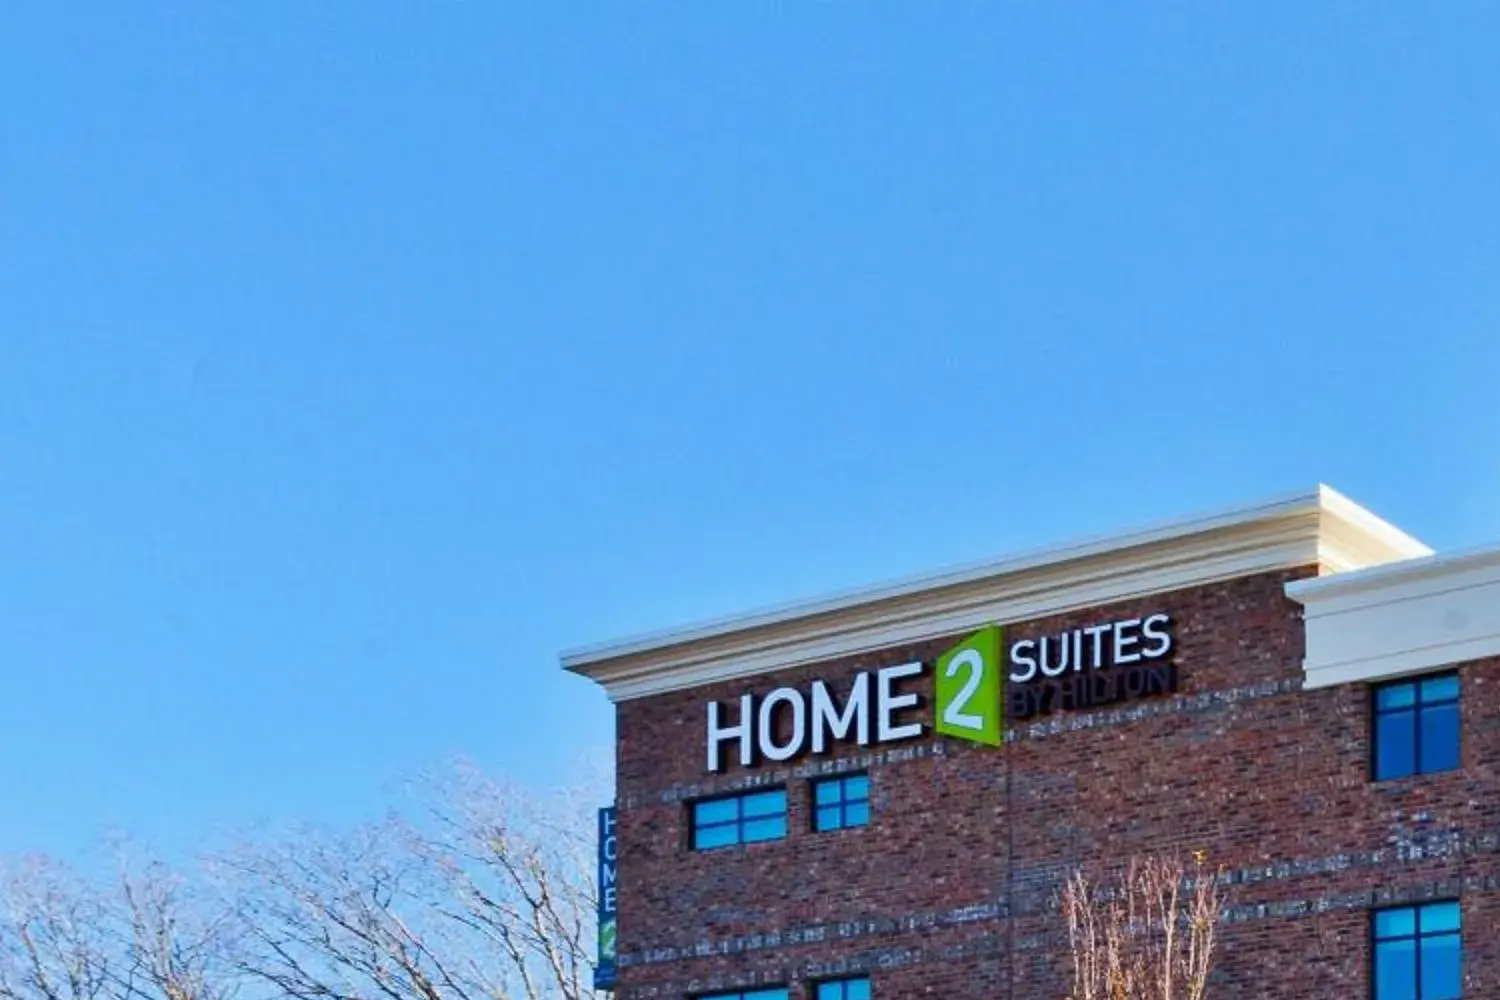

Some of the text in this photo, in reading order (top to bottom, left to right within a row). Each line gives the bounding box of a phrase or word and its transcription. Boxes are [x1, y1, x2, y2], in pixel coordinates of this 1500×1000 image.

[707, 613, 1171, 771] HOME 2 SUITES
[1009, 665, 1172, 716] BY HILTON
